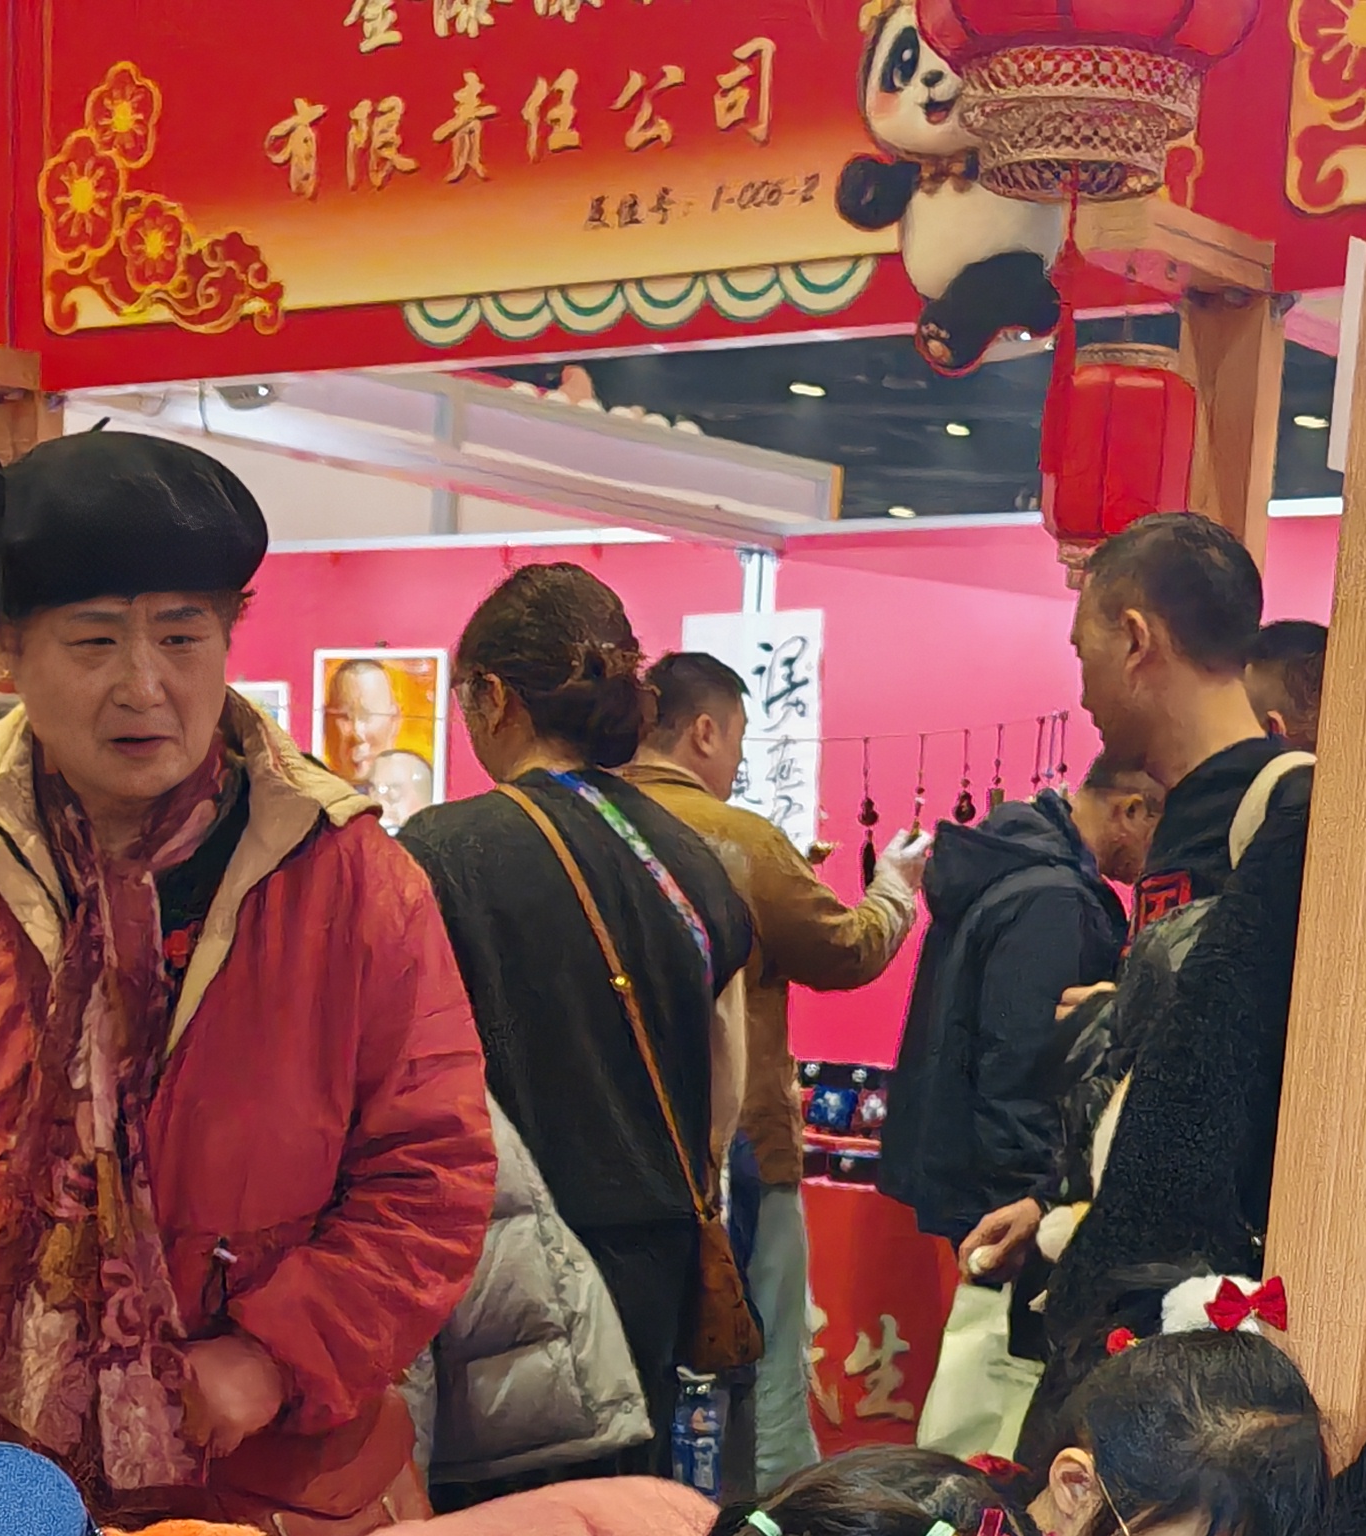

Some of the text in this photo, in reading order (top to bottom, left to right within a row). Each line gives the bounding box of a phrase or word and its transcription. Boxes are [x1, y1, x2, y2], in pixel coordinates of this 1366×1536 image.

[263, 37, 777, 200] 有限责任公司
